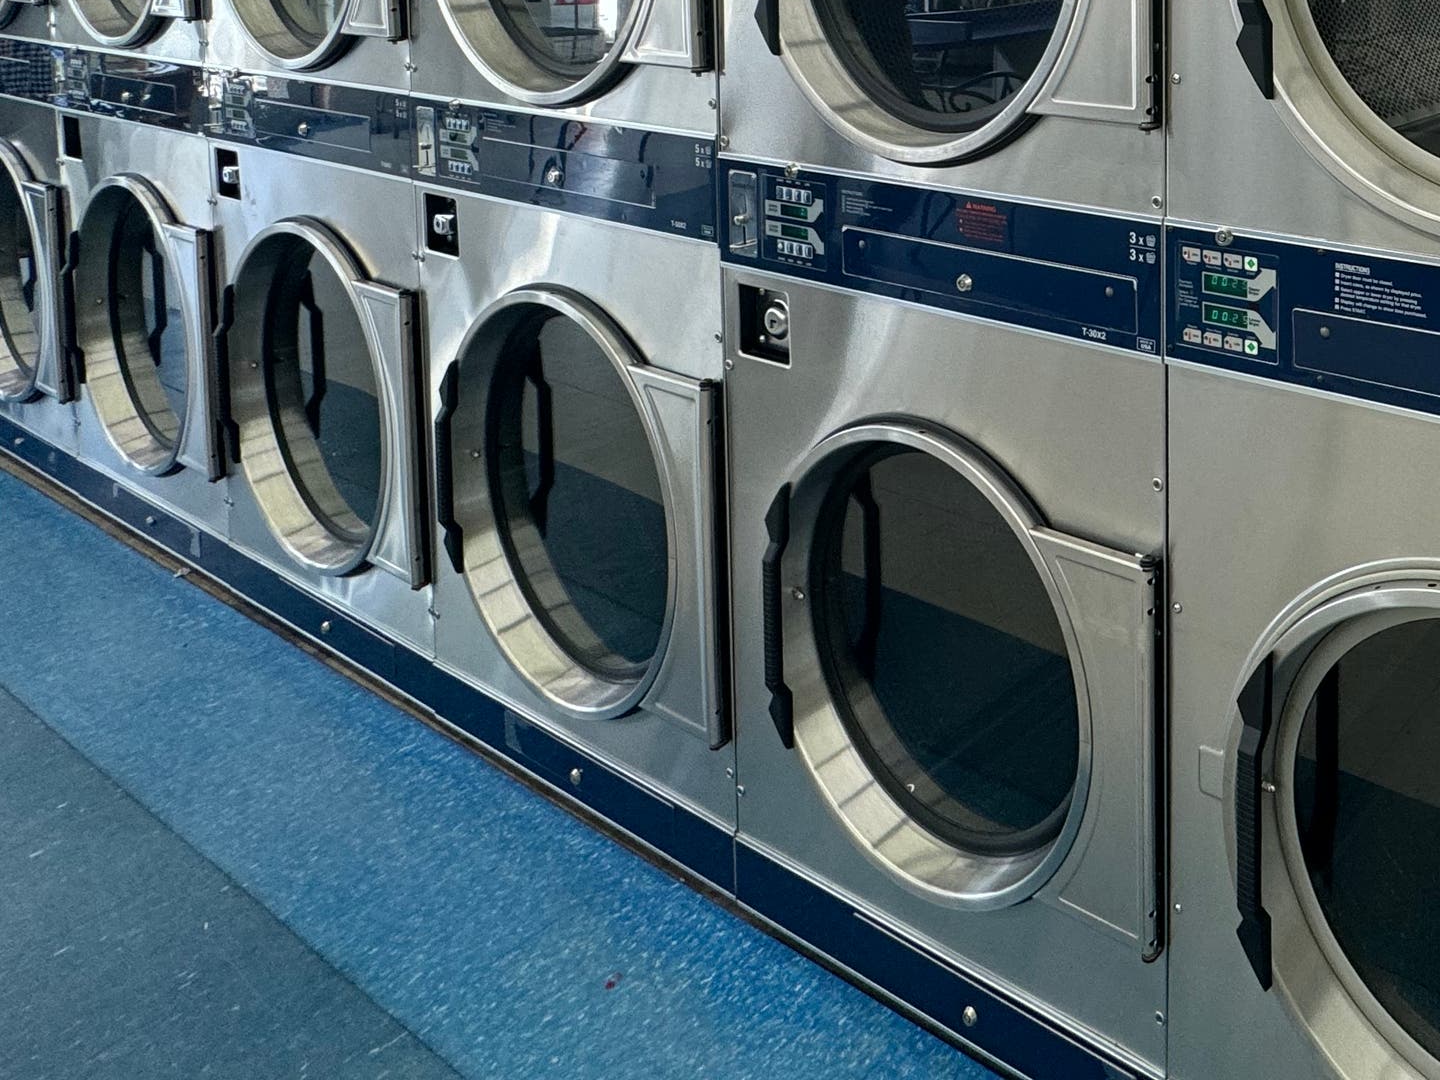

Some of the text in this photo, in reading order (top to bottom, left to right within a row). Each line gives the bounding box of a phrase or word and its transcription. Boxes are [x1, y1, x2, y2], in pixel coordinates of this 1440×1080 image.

[1129, 231, 1144, 246] 3 x
[1129, 249, 1144, 263] 3 x
